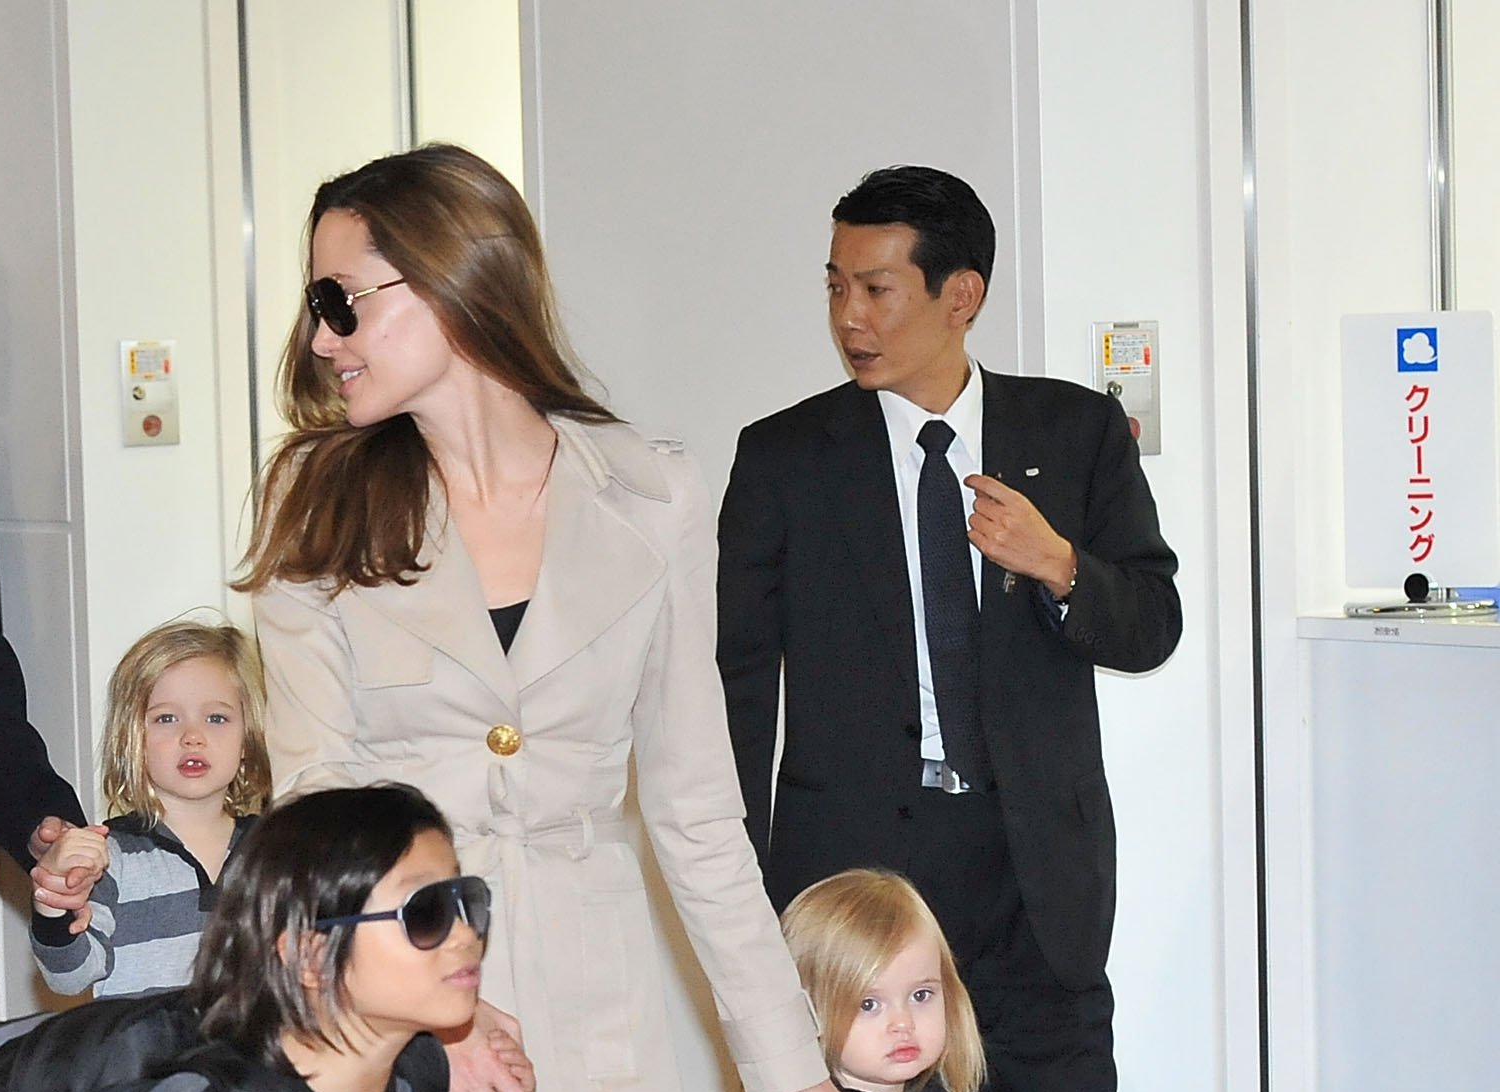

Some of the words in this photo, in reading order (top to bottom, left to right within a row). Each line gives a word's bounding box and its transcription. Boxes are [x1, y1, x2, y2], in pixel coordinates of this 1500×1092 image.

[1405, 385, 1435, 562] クリーニング
